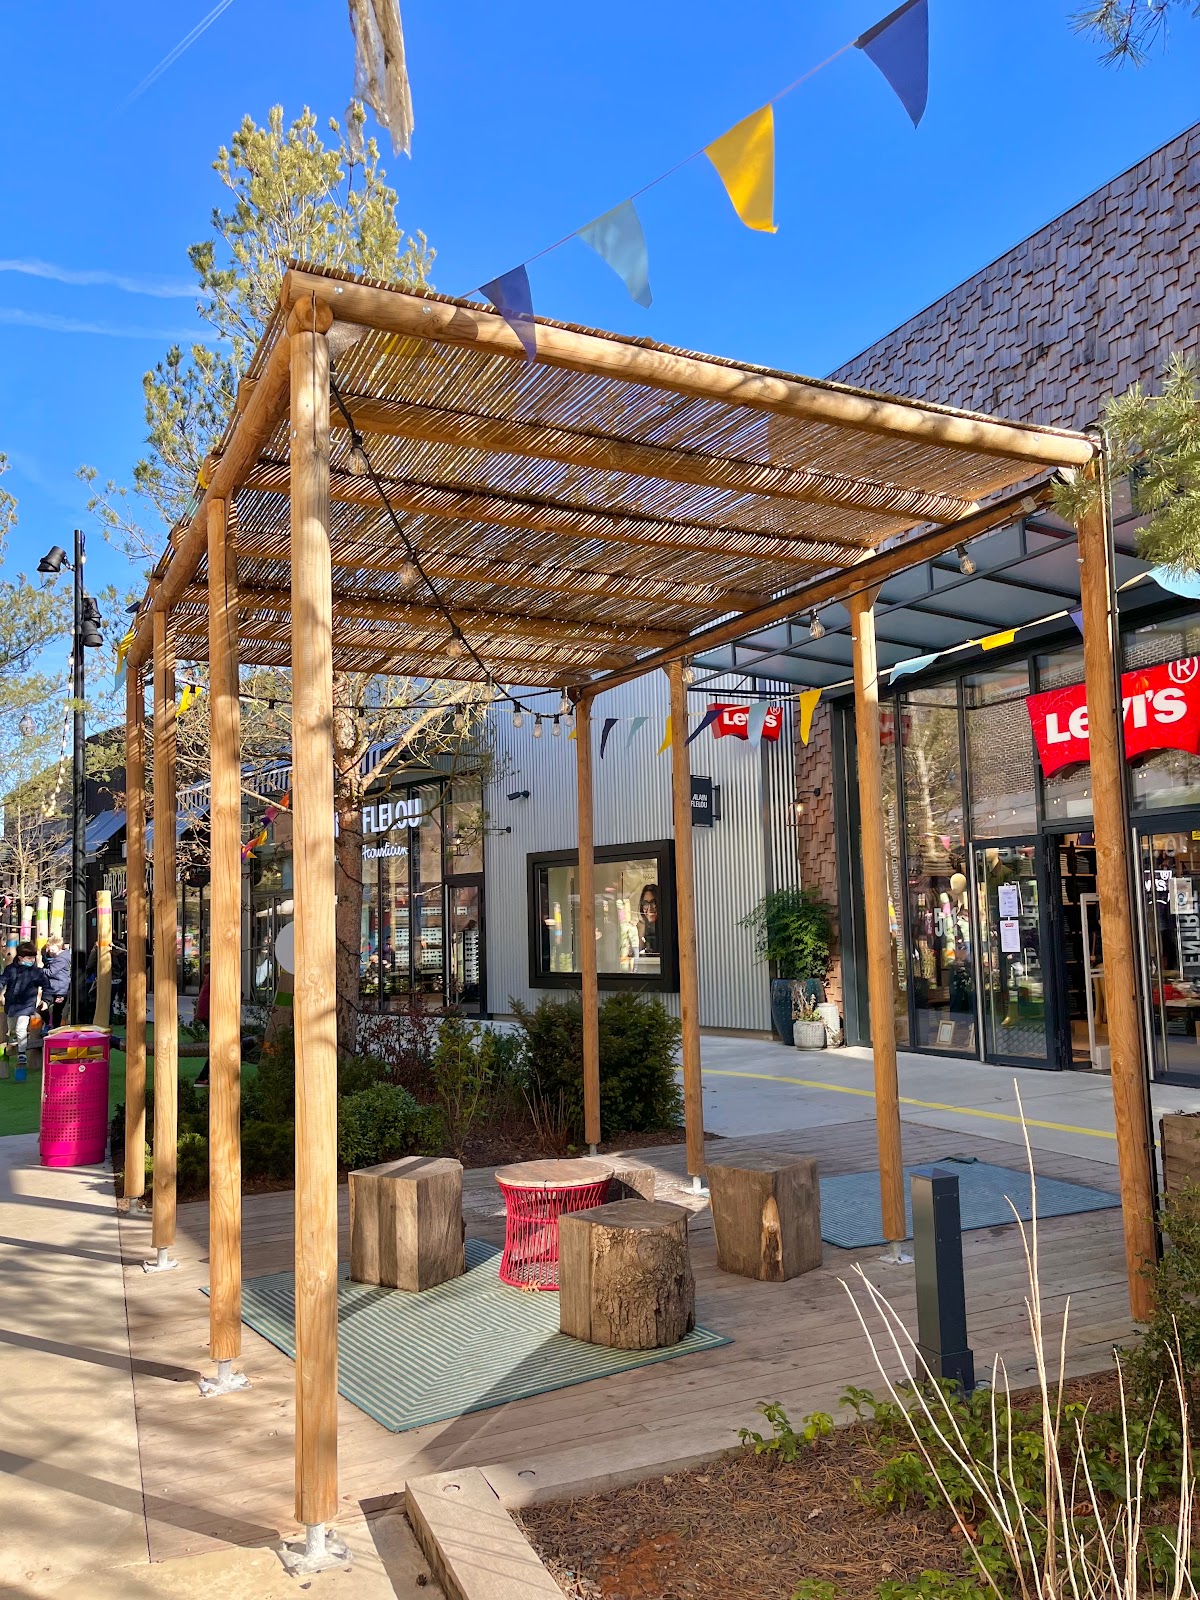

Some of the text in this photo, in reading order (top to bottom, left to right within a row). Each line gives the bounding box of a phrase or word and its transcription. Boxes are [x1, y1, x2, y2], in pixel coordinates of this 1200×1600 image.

[891, 858, 900, 899] CHANGED
[896, 924, 904, 960] NUMBER
[897, 962, 905, 980] THE
